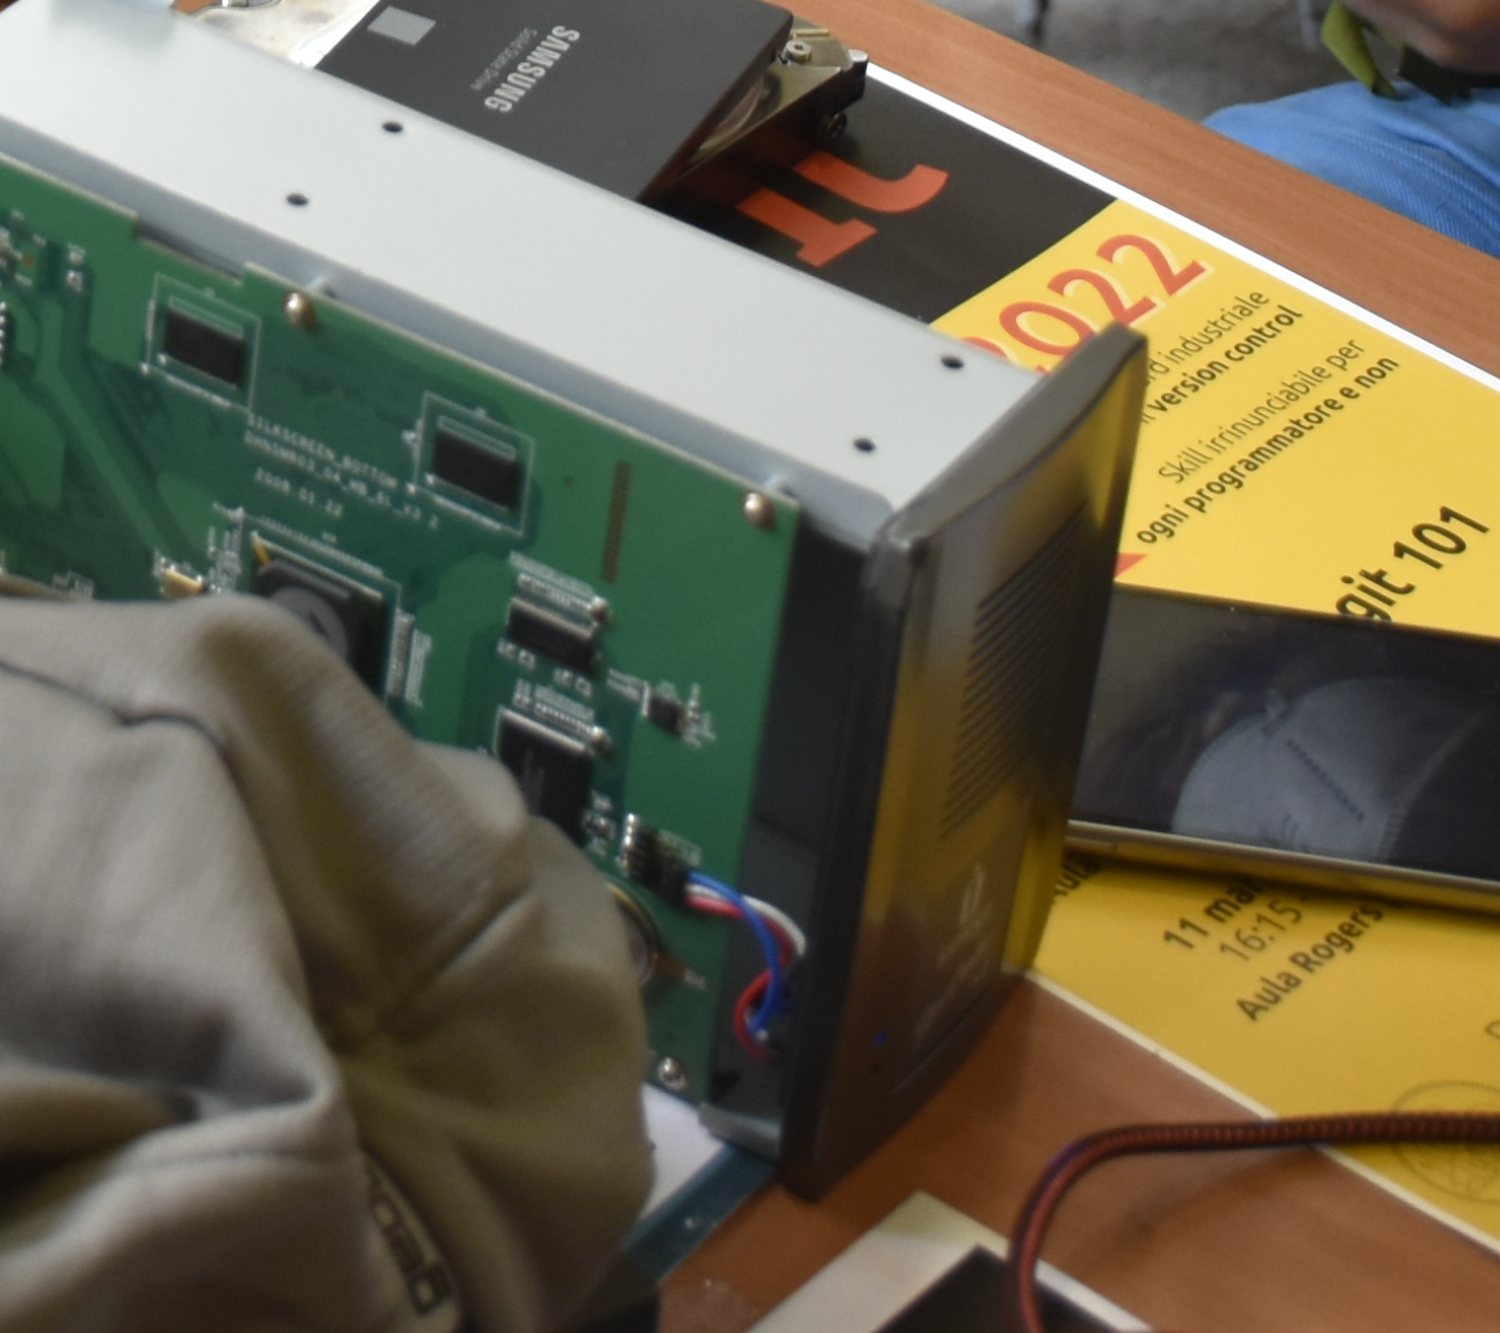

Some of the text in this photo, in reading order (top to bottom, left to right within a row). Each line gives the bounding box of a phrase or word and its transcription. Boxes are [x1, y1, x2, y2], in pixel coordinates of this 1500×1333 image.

[484, 25, 580, 112] SAMSUNG
[961, 234, 1210, 376] 022
[1147, 304, 1304, 413] version control
[1164, 290, 1270, 365] industriale
[1136, 503, 1190, 545] ogni
[1182, 397, 1345, 515] programmatore
[1339, 386, 1361, 401] e
[1353, 356, 1401, 390] non
[1158, 446, 1213, 485] Skill
[1198, 364, 1333, 455] irrinunciabile
[1326, 339, 1365, 372] per
[1334, 504, 1490, 624] git 101
[1163, 917, 1211, 951] 11
[1219, 898, 1304, 962] 16:15
[1236, 900, 1385, 1022] Aula Rogers
